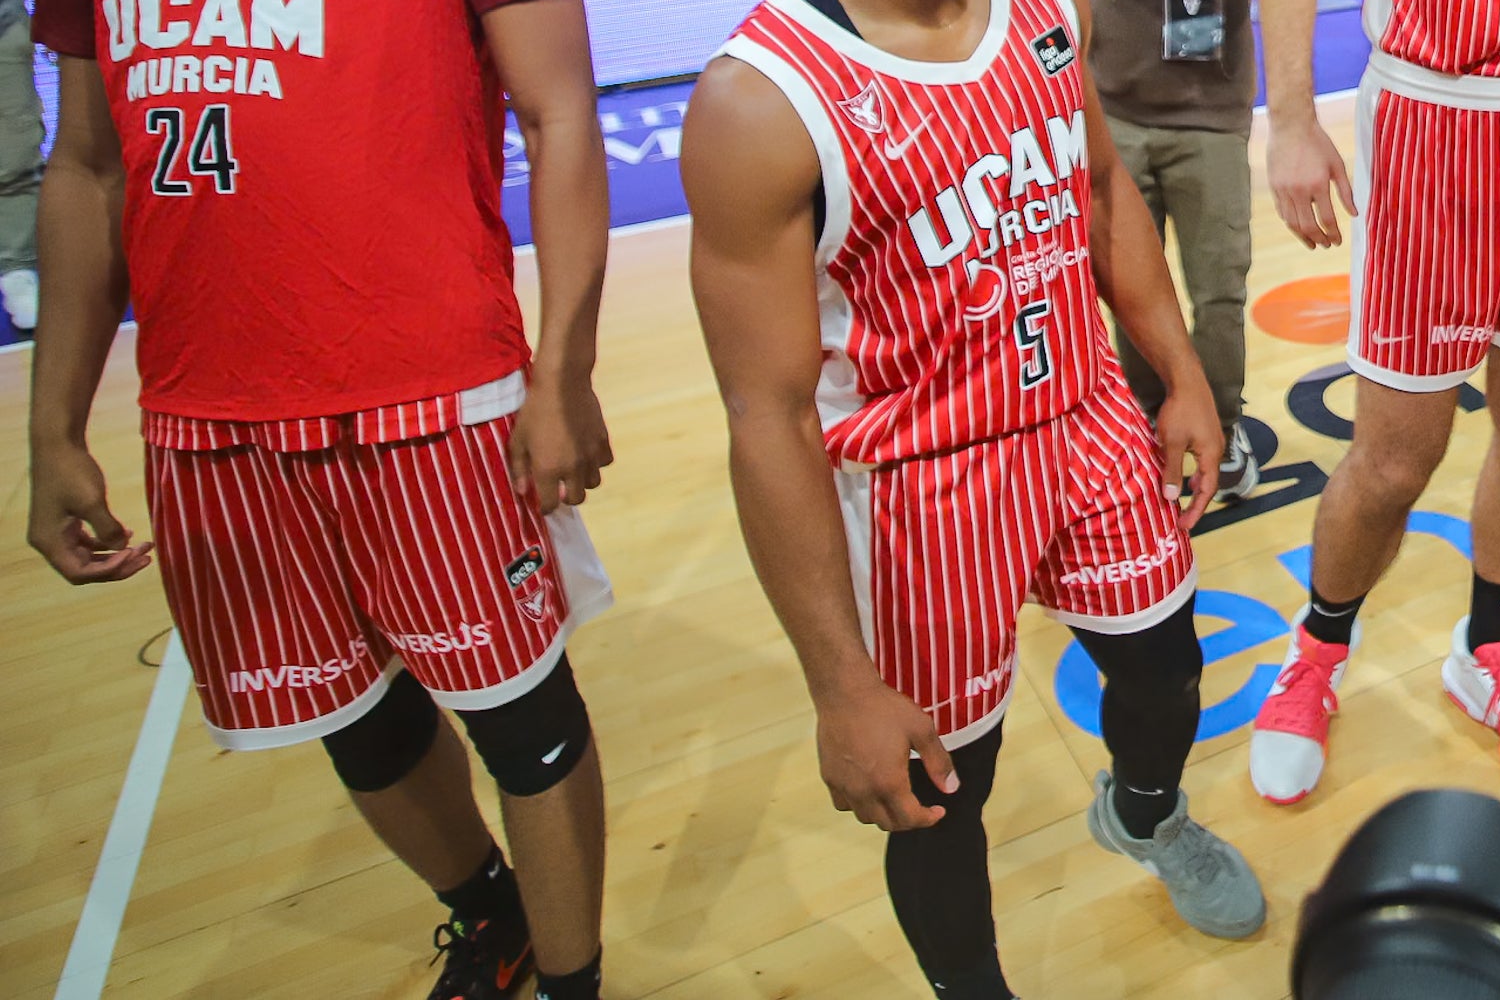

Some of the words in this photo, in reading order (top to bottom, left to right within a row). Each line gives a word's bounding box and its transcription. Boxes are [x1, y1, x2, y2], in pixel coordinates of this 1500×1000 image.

[127, 55, 284, 102] MURCIA
[145, 103, 239, 197] 24
[906, 108, 1088, 269] UCAM
[1013, 299, 1054, 391] 5
[508, 556, 539, 587] acb
[230, 632, 368, 694] INVERSUS
[387, 620, 492, 654] VERSUS
